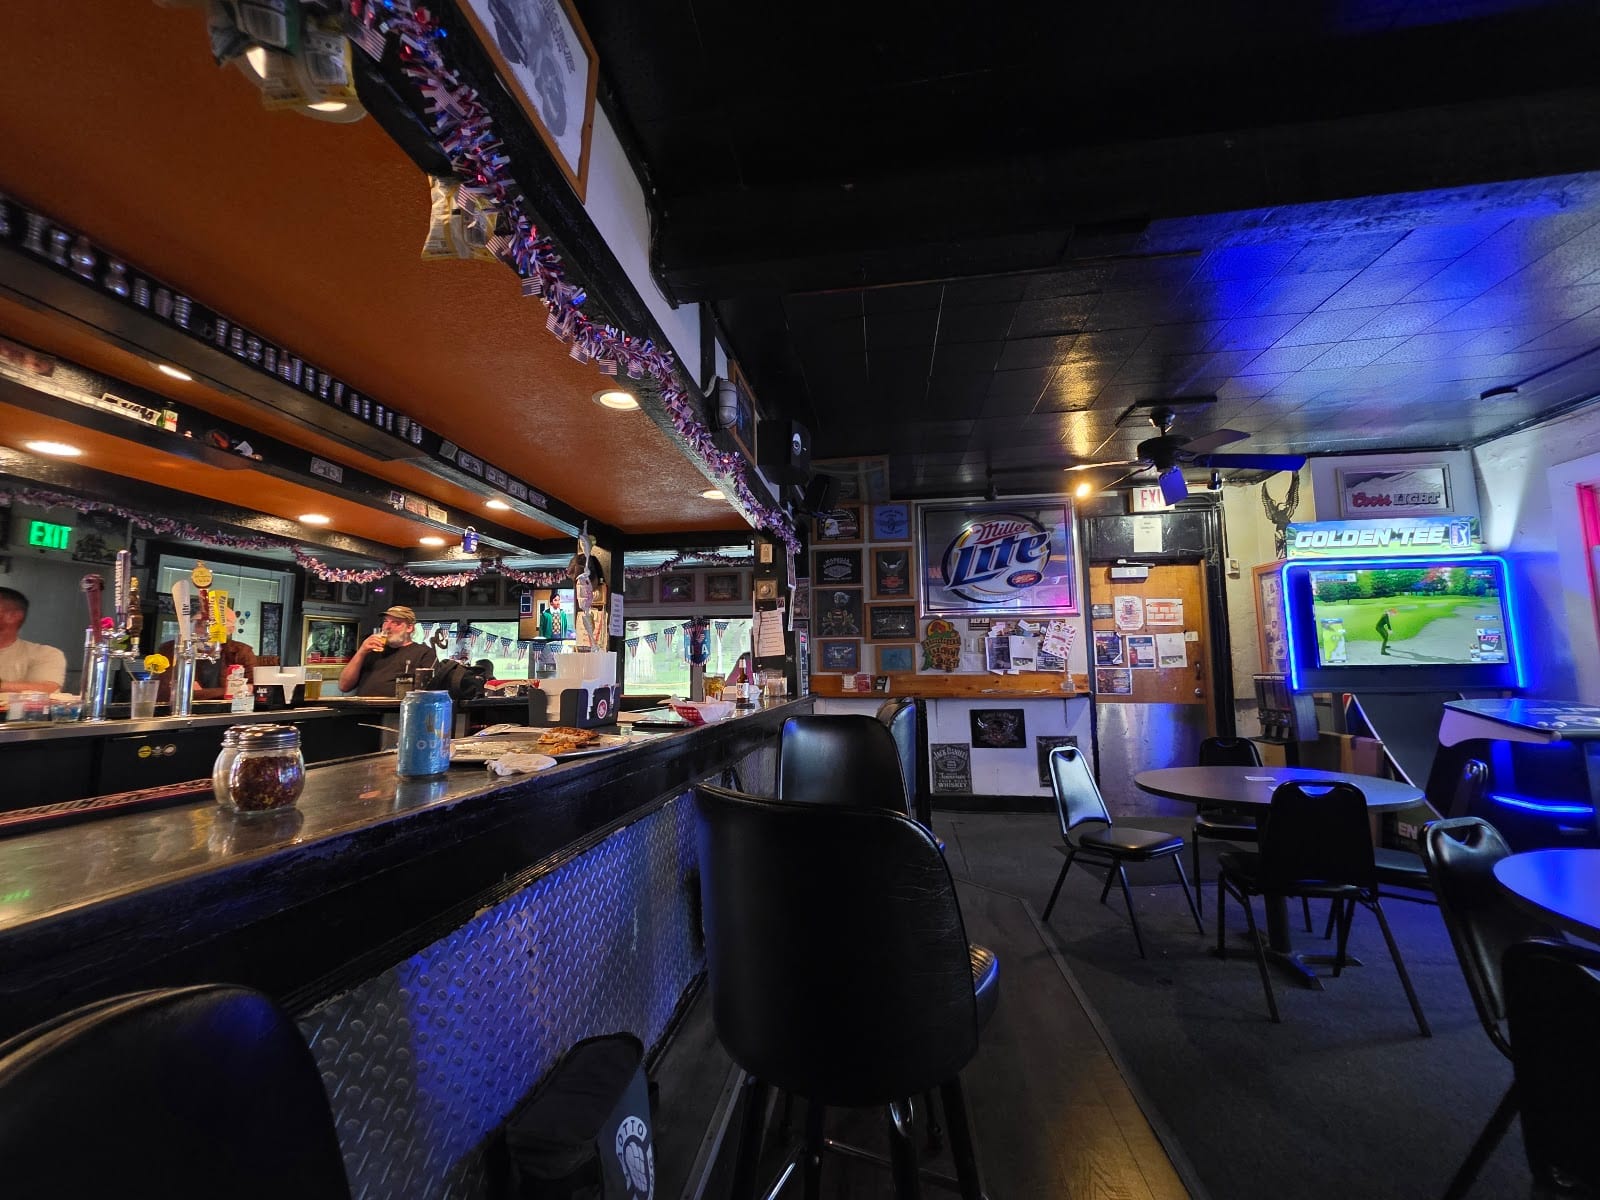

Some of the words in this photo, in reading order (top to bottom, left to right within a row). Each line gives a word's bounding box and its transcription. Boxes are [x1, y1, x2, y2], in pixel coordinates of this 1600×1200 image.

[1140, 489, 1161, 509] EXI
[1352, 492, 1392, 508] Coors
[1393, 492, 1440, 506] LIGHT
[29, 520, 72, 550] EXIT
[973, 521, 1031, 542] Miller
[1295, 528, 1392, 548] GOLDEN
[1397, 526, 1446, 546] TEE
[687, 642, 709, 656] UA
